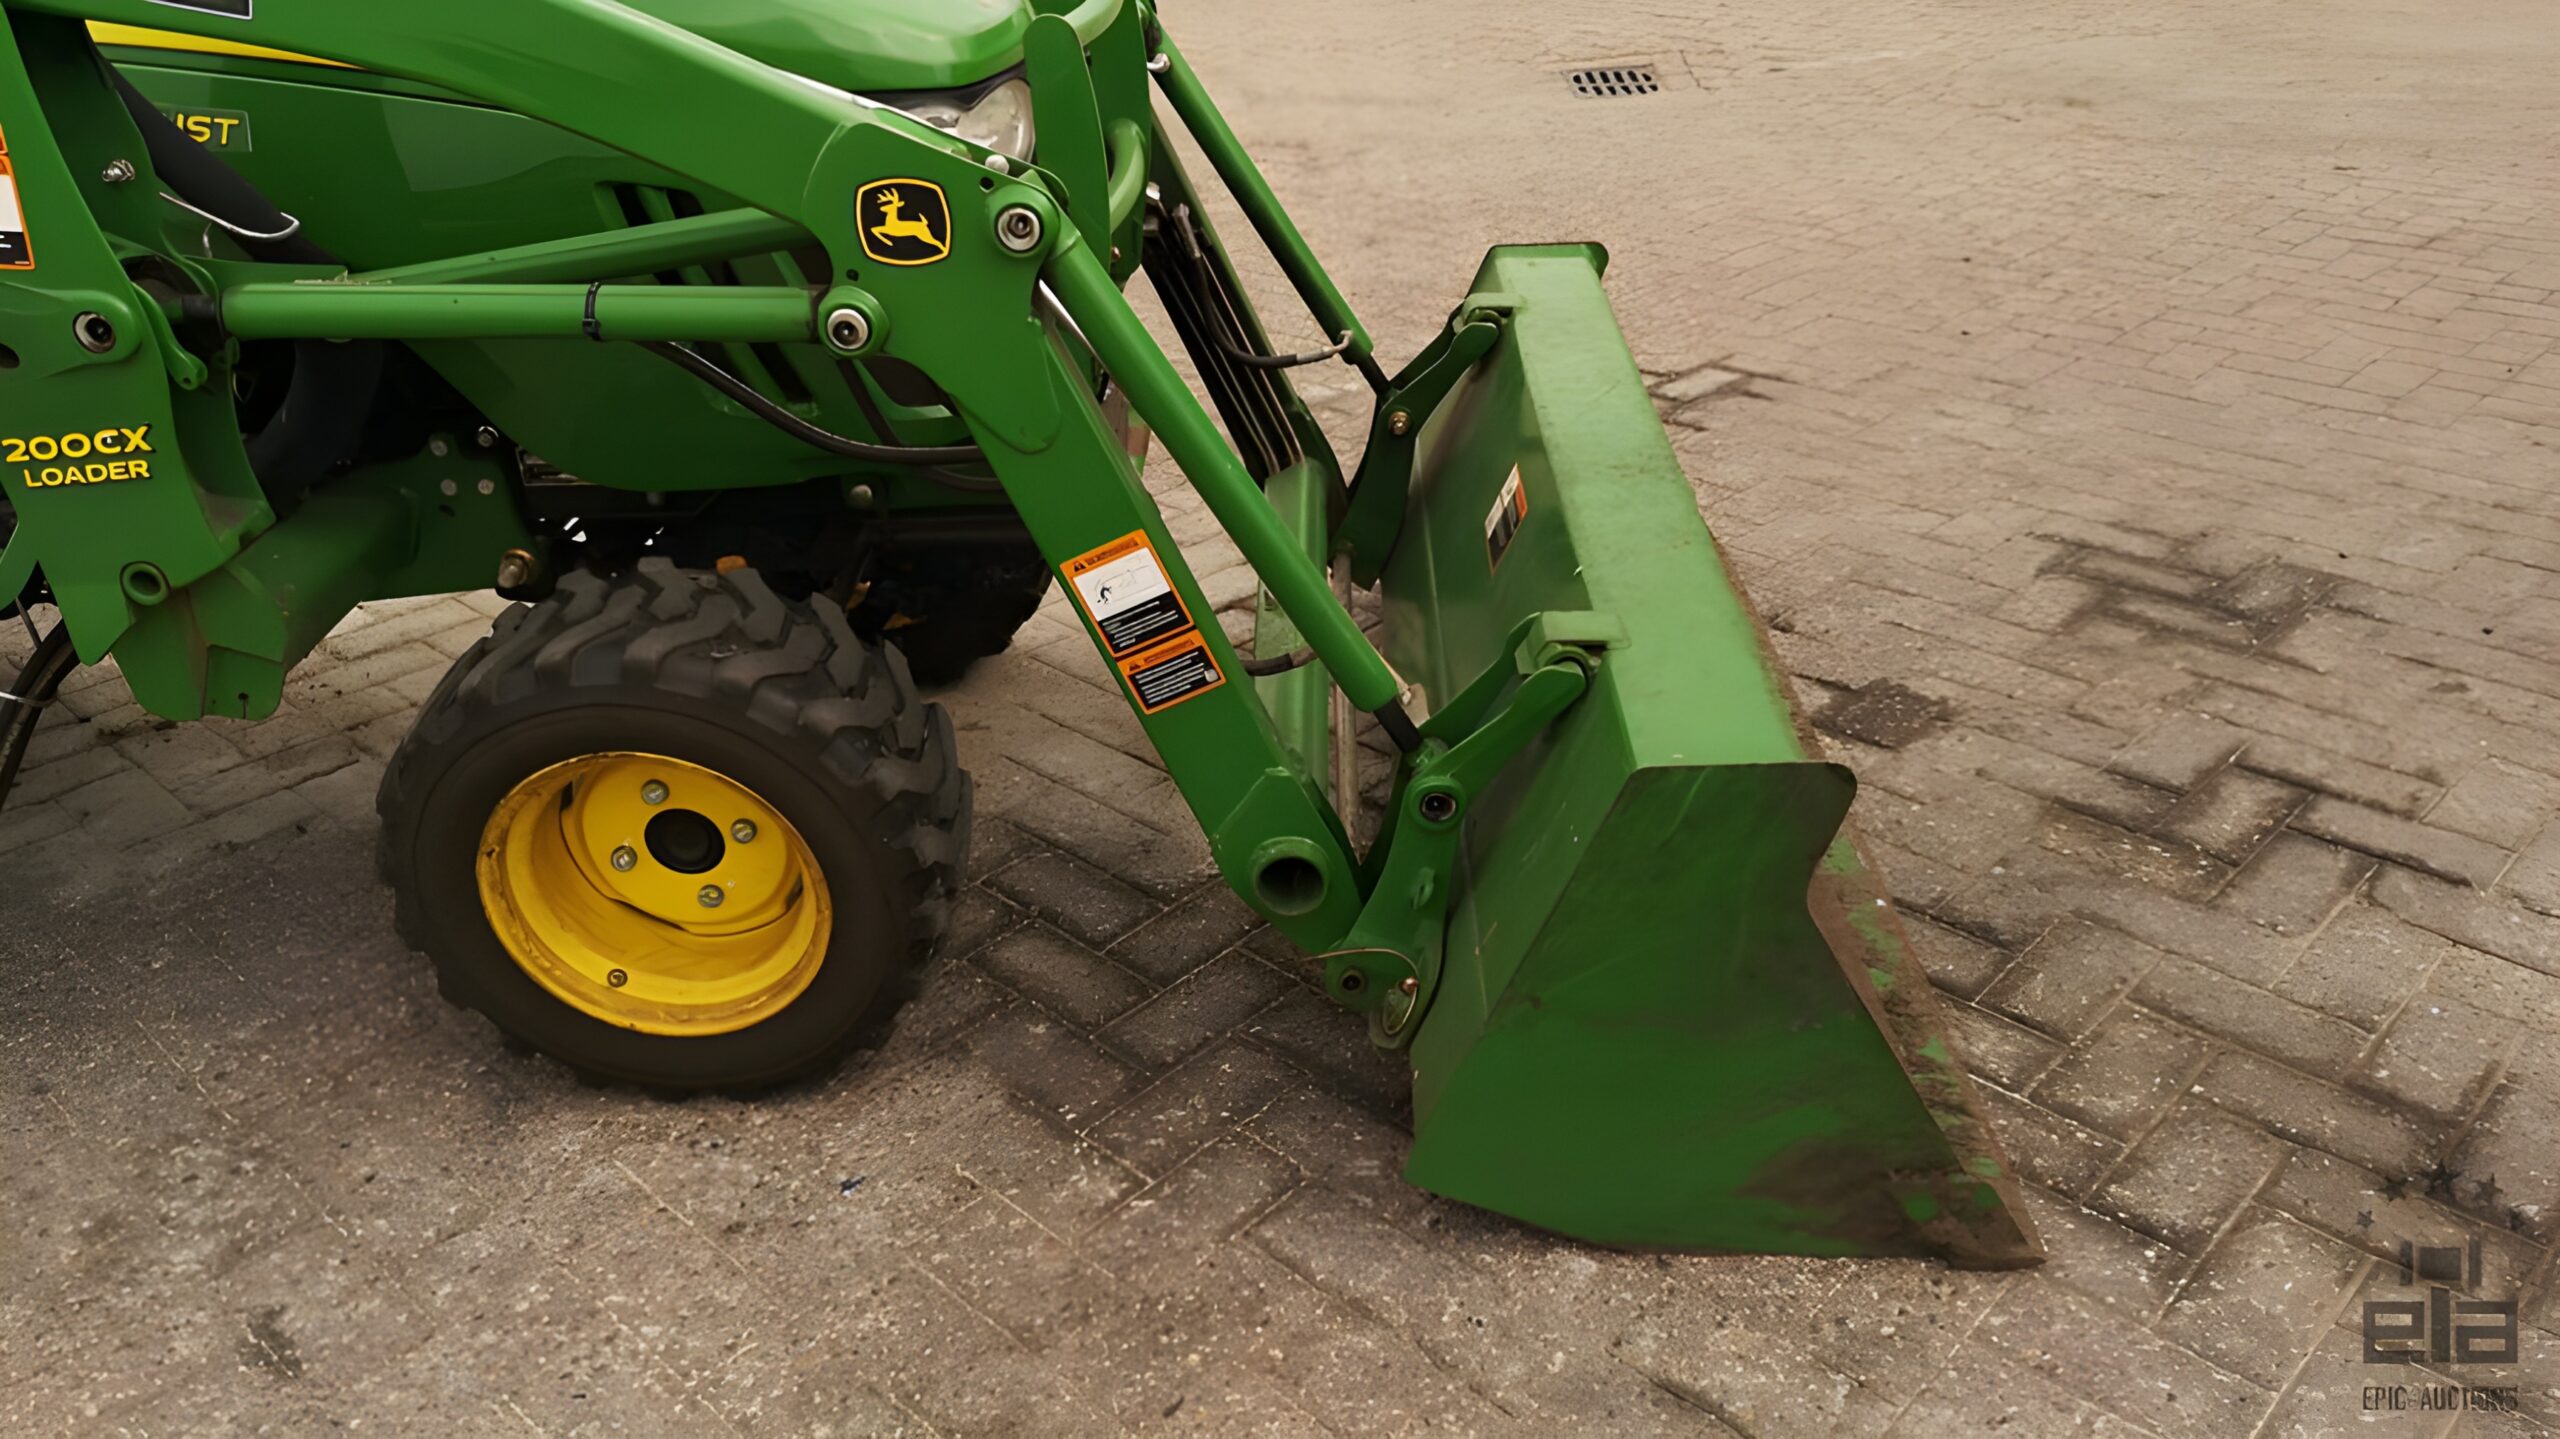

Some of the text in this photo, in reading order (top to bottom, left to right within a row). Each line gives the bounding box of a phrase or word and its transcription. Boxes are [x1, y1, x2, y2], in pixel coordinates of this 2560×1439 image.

[176, 112, 239, 145] ST
[1, 425, 153, 462] 200CX
[23, 459, 151, 488] LOADER
